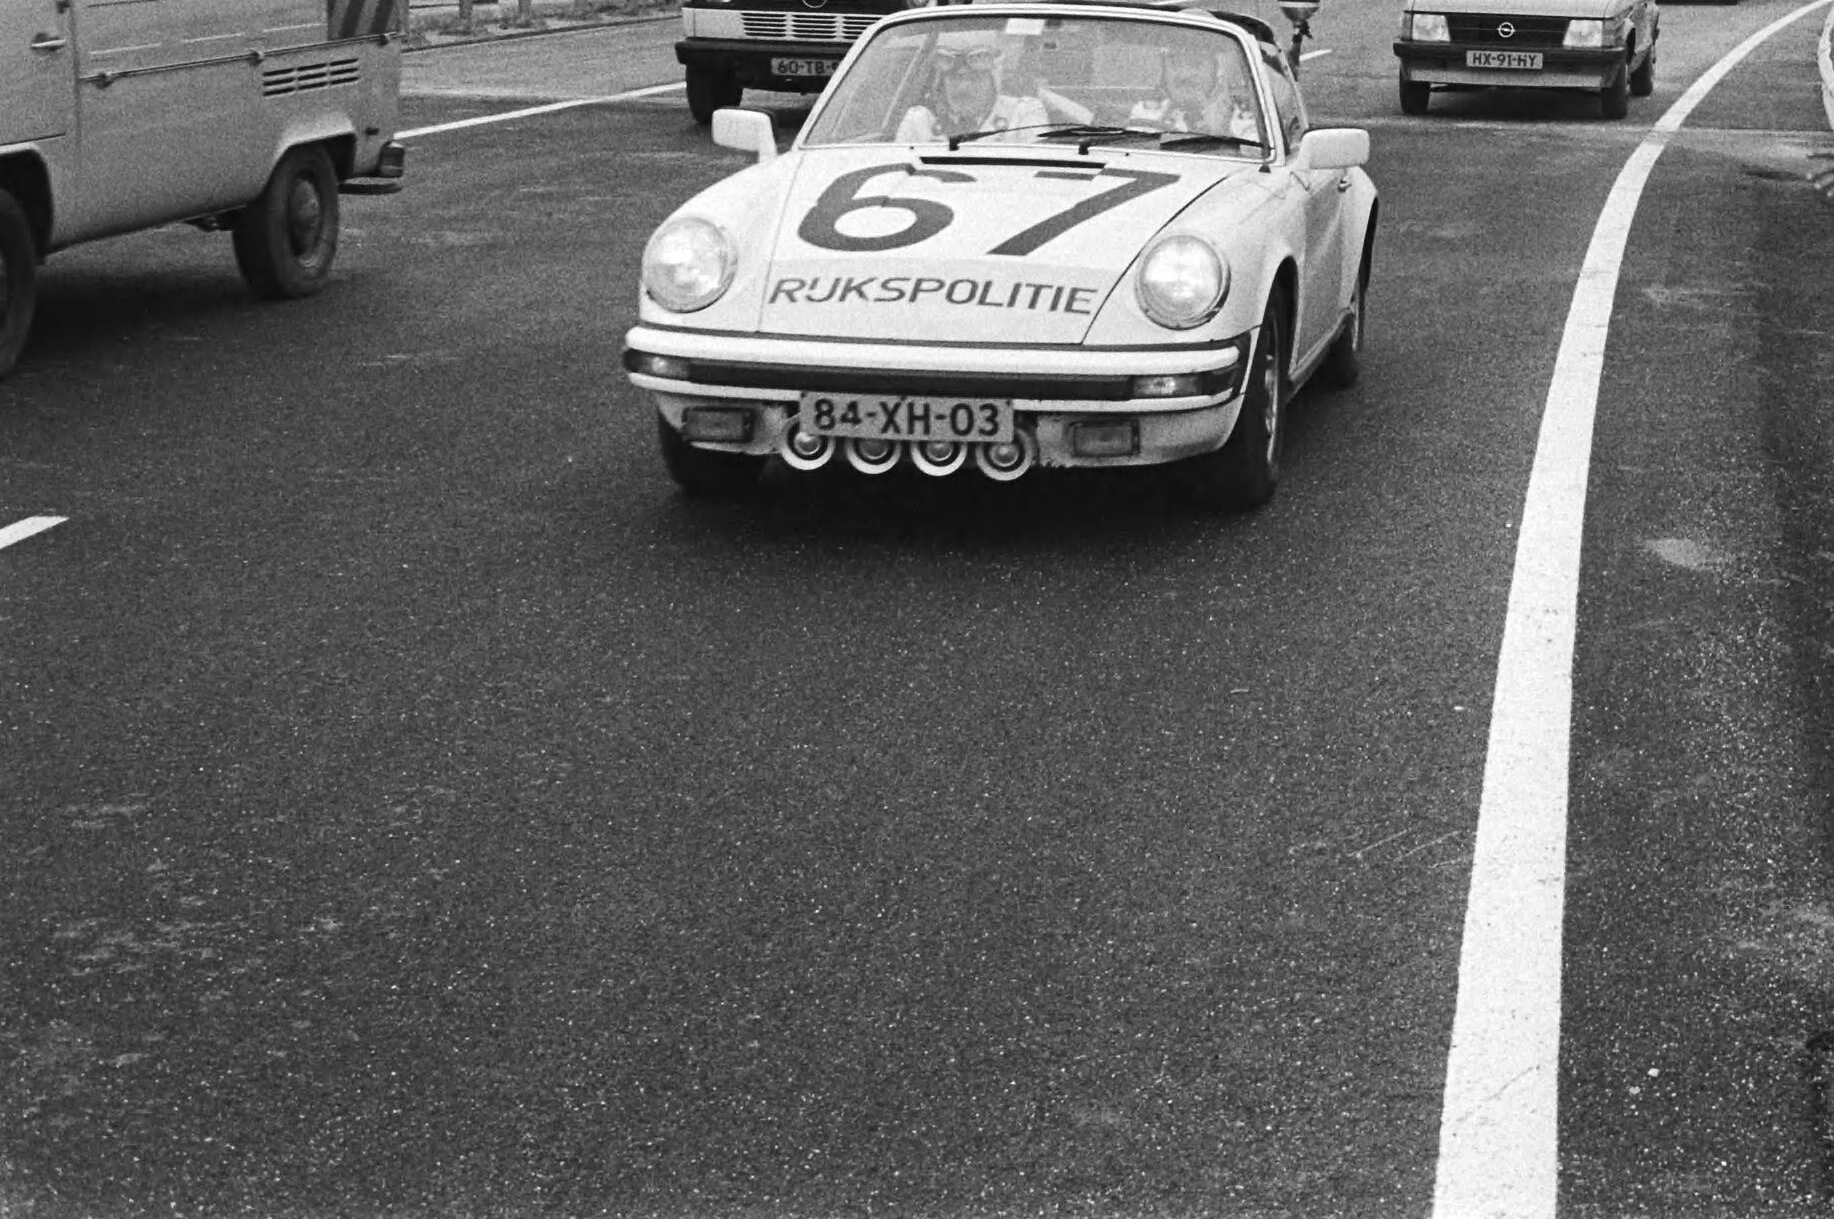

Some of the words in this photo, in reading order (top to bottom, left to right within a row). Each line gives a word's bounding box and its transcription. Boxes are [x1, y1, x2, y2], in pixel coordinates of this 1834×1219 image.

[1472, 52, 1537, 68] HX-91-HY
[797, 162, 1182, 257] 67
[769, 276, 1099, 316] RIJKSPOLITIE
[813, 398, 1000, 437] 84-XH-03
